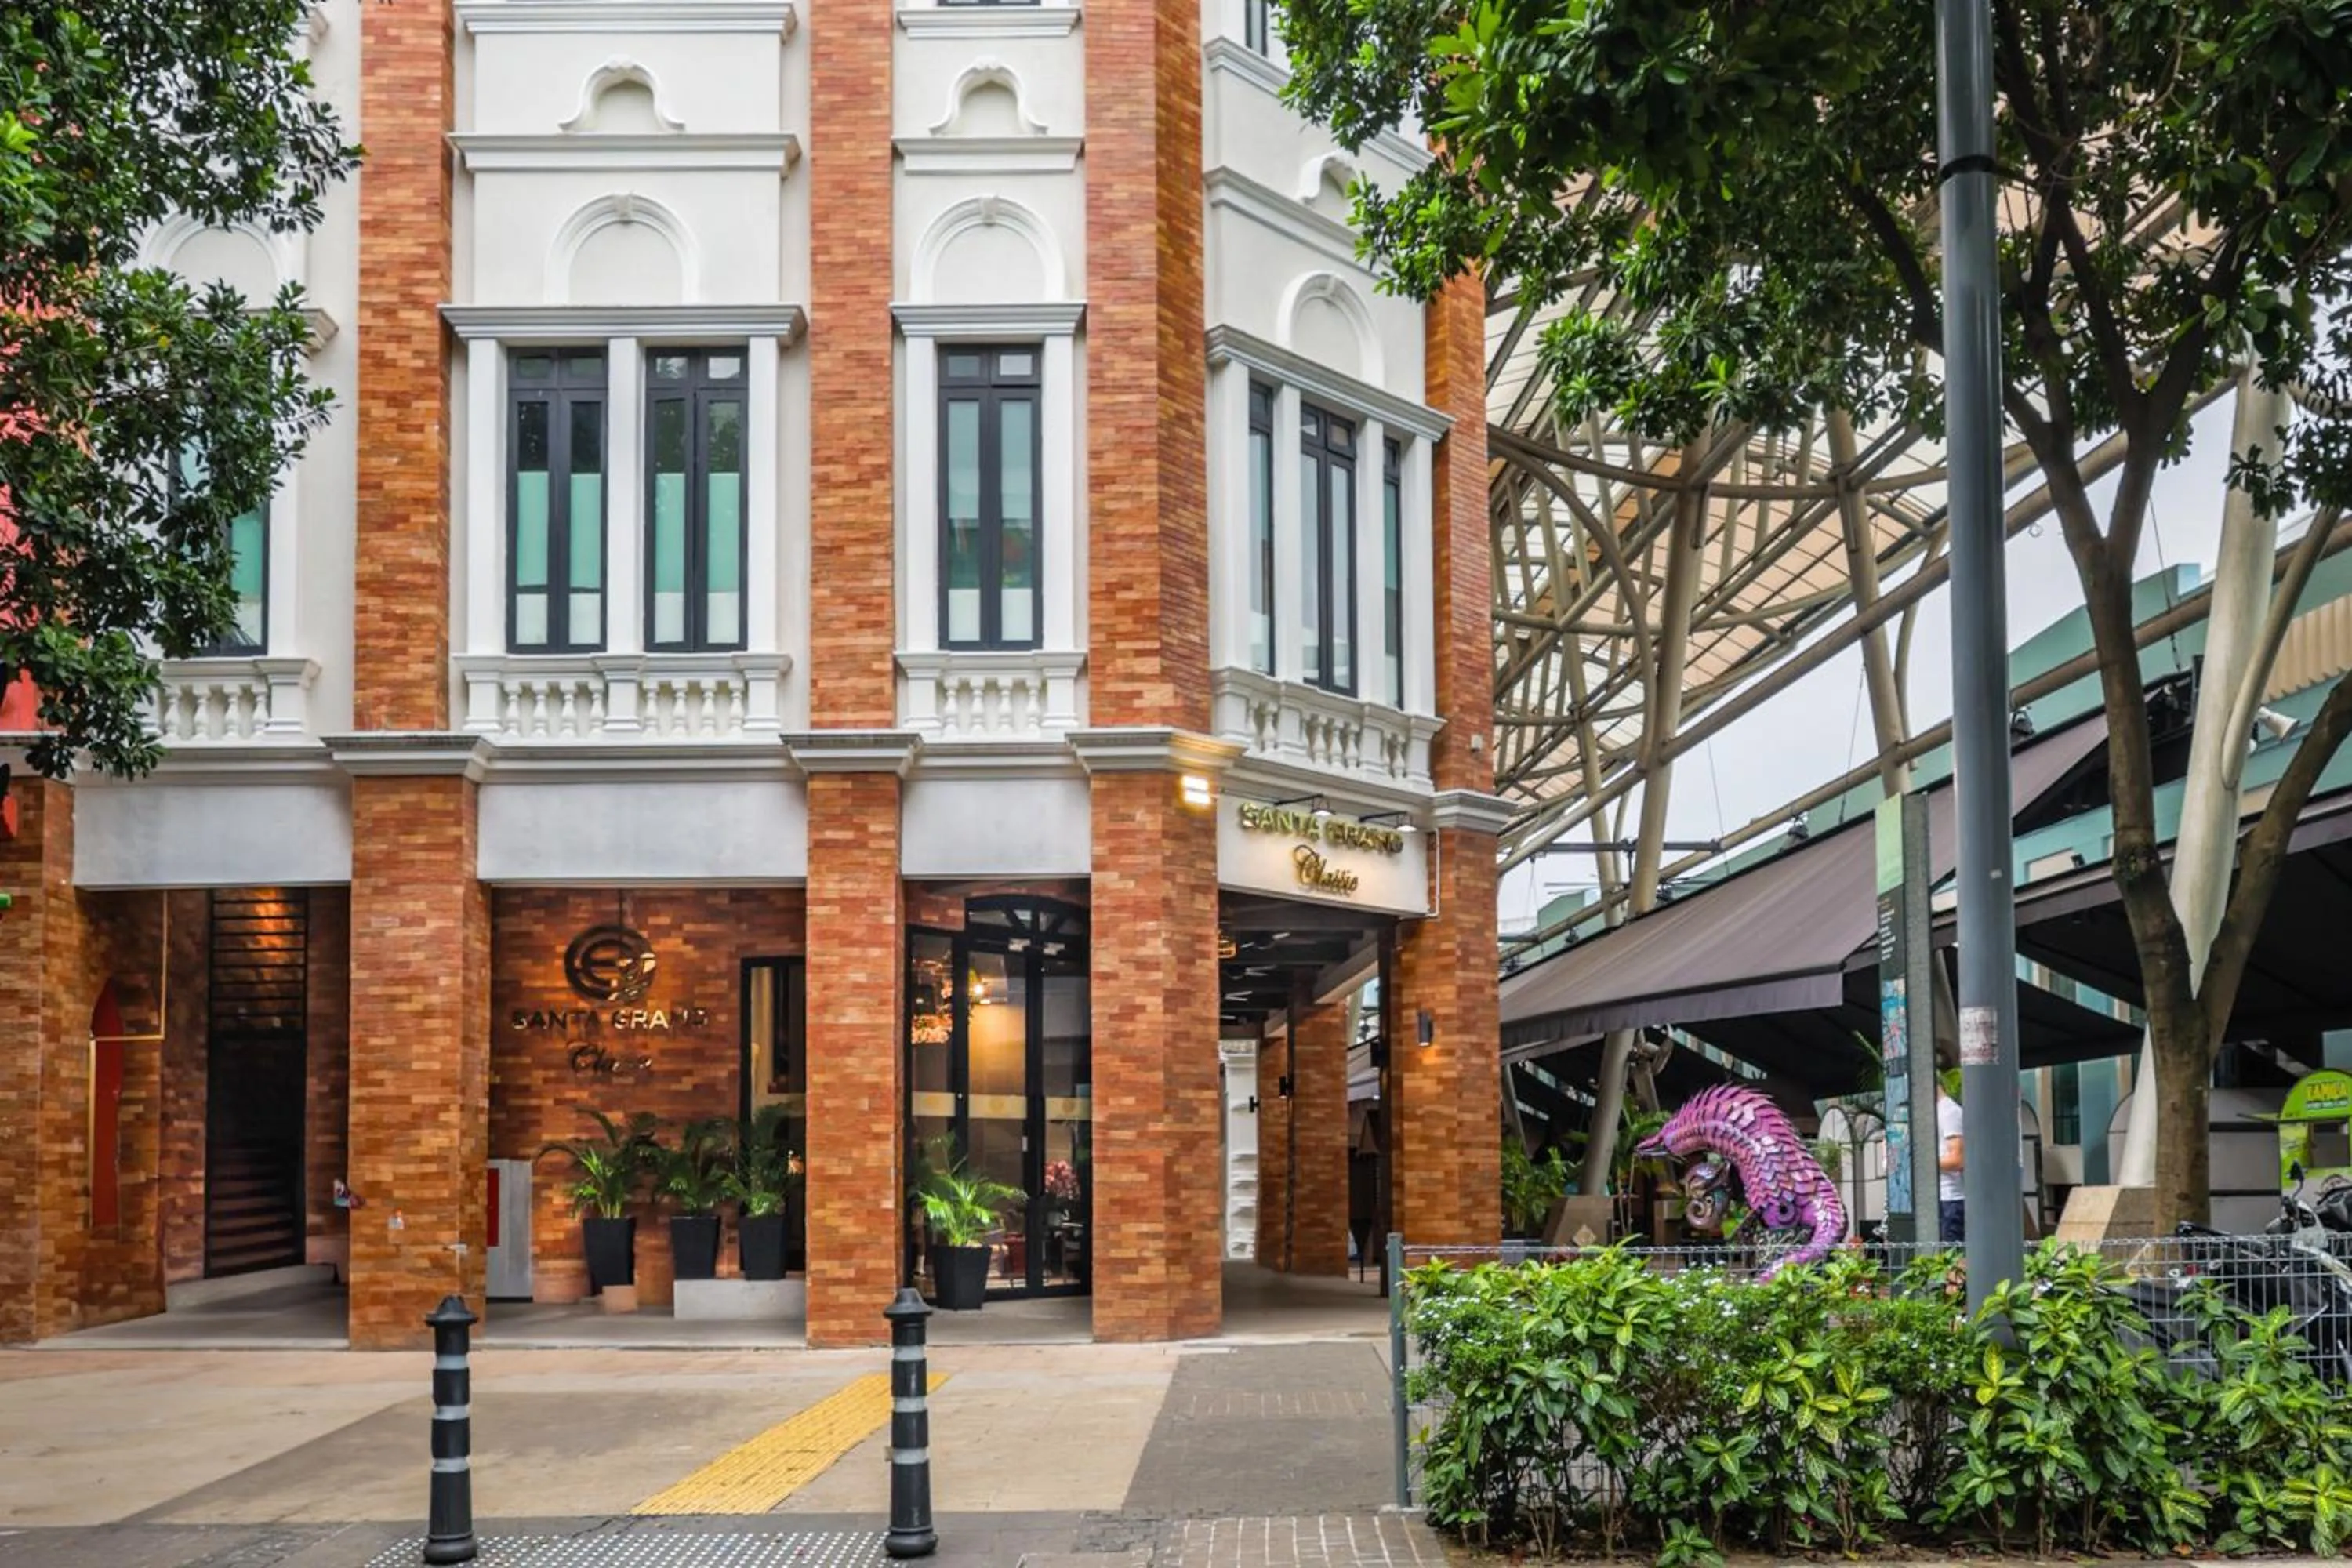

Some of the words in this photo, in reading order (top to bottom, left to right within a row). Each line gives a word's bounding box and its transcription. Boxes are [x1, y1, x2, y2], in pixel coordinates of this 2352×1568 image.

[1239, 802, 1320, 842] SANTA
[1325, 819, 1403, 853] GRAND
[511, 1008, 601, 1031] SANTA
